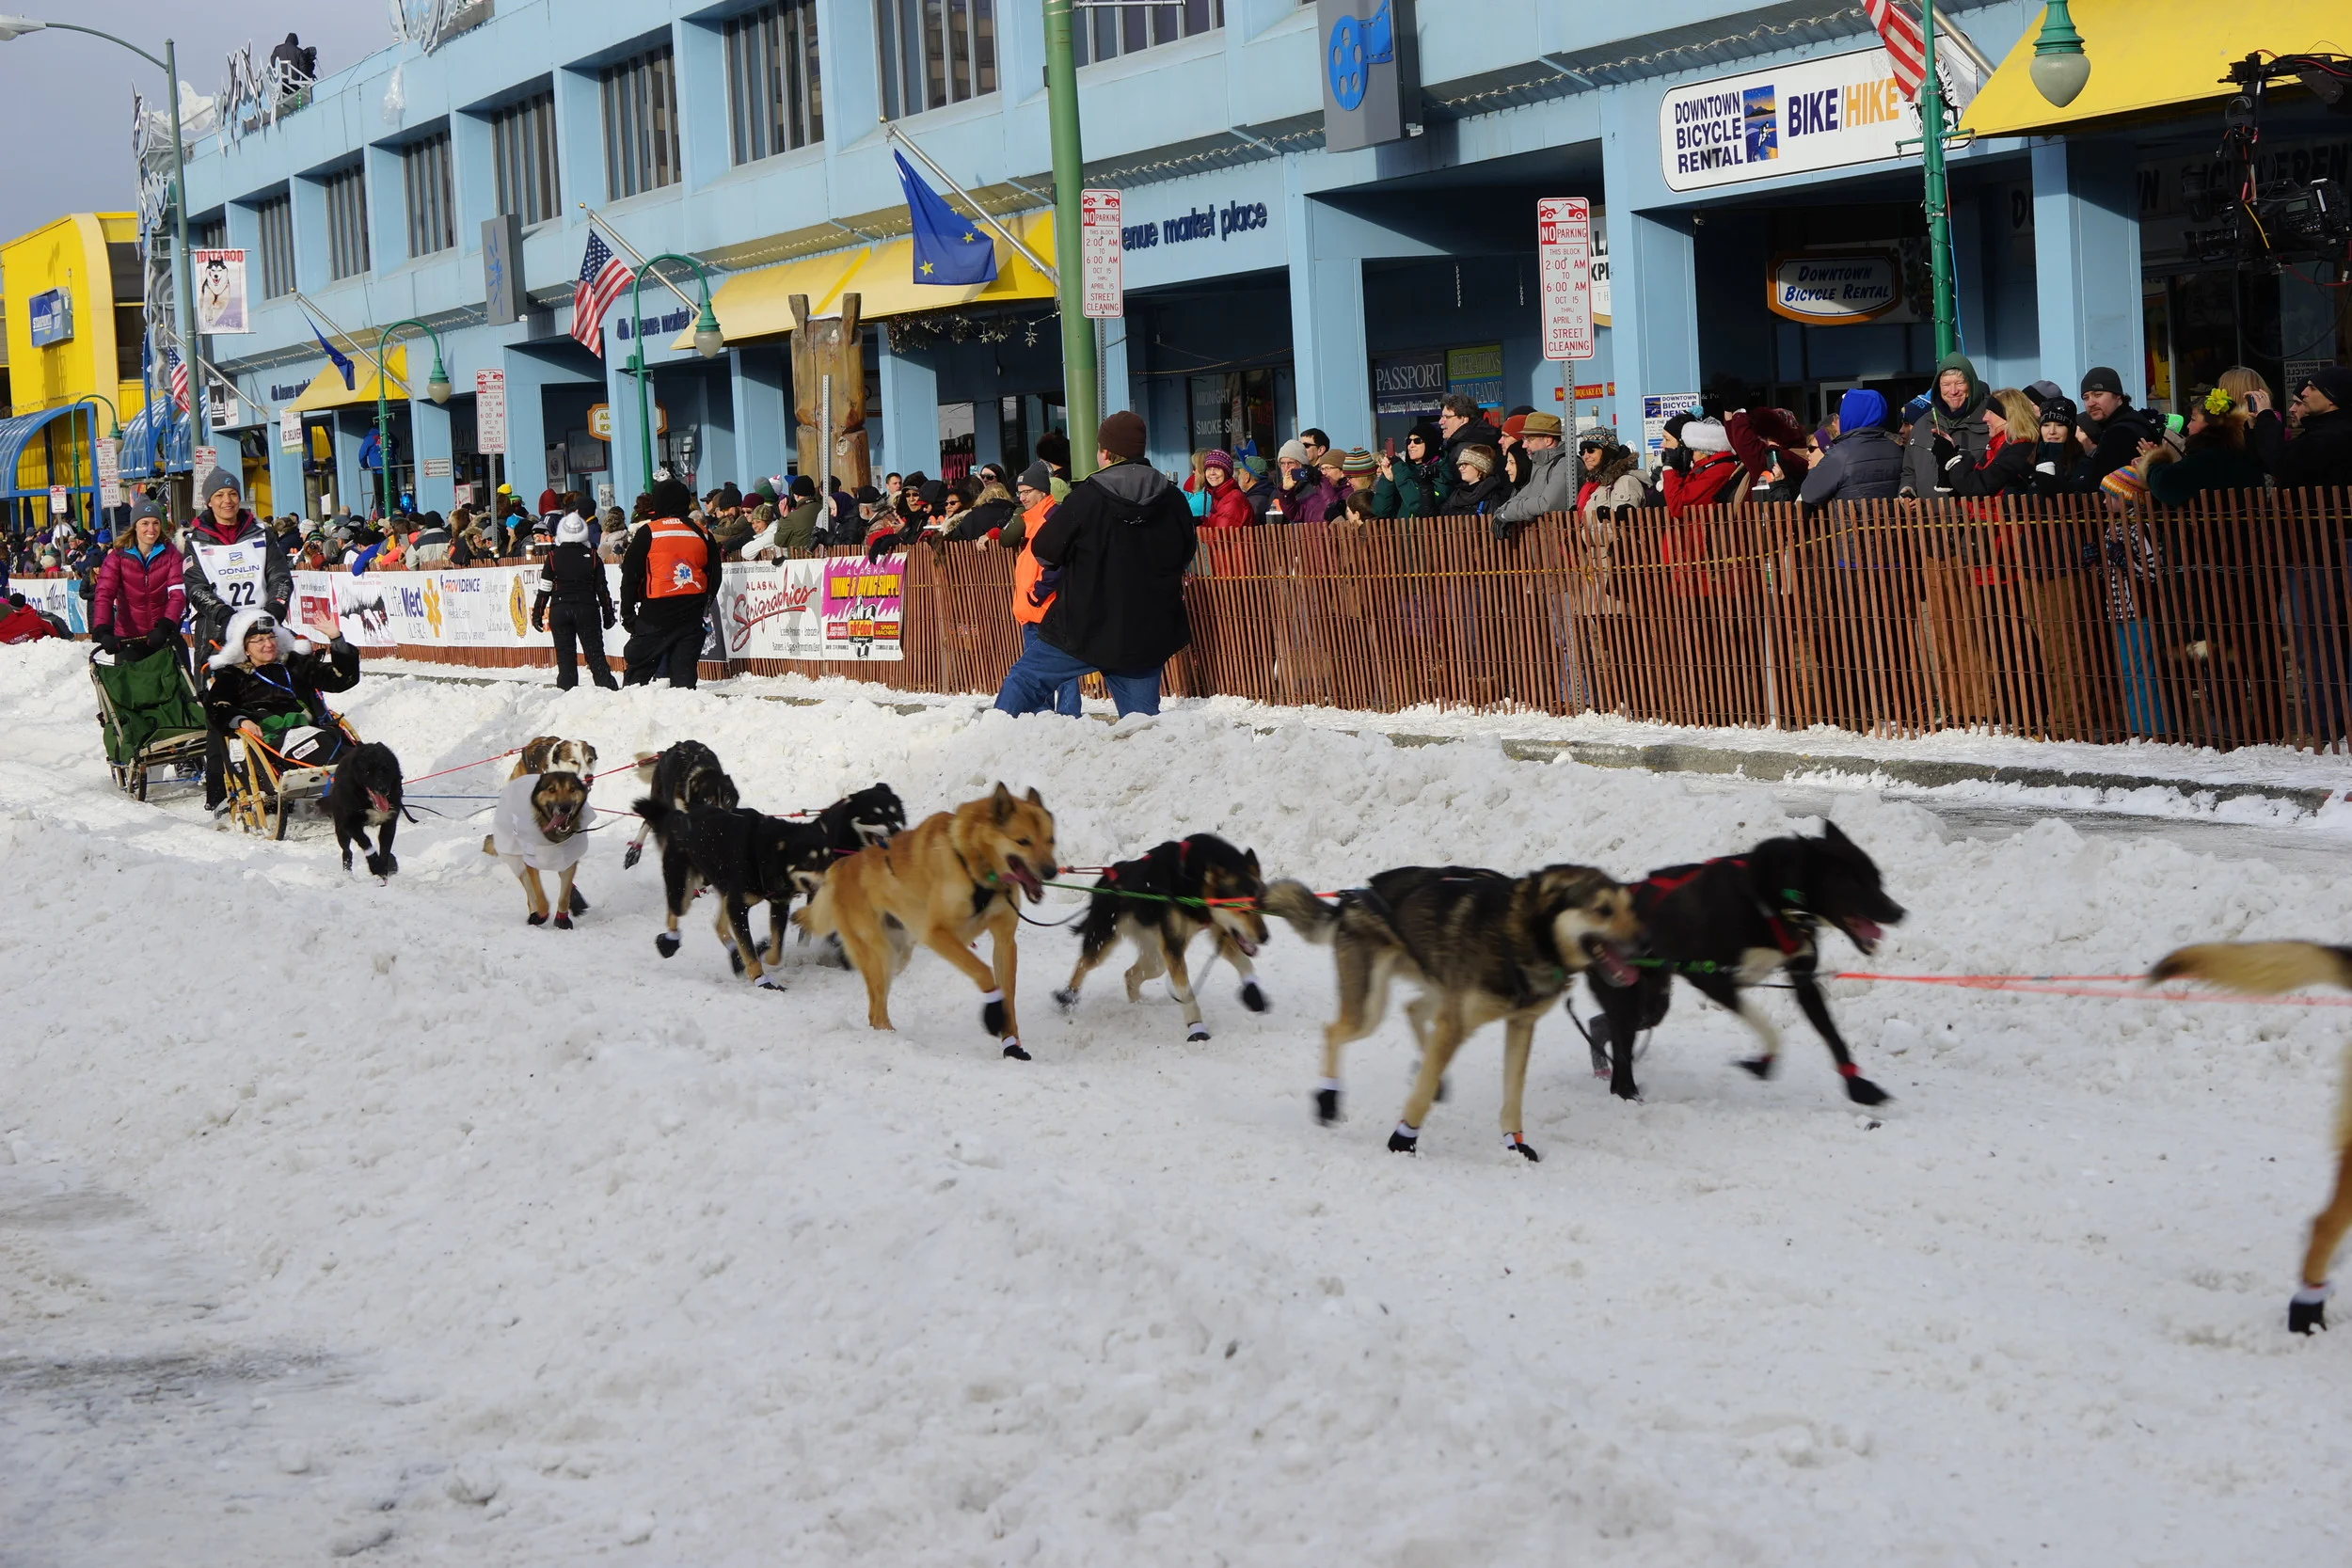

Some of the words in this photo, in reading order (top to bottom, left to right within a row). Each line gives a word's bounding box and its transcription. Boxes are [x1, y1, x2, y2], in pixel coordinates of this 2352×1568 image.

[1675, 91, 1740, 124] DOWNTOWN
[1677, 117, 1742, 150] BICYCLE
[1677, 144, 1743, 174] RENTAL
[1084, 211, 1095, 225] NO
[1095, 214, 1120, 223] PARKING
[1121, 221, 1159, 251] enue
[1163, 203, 1216, 245] market
[1220, 199, 1268, 242] place
[1541, 225, 1556, 242] NO
[1556, 227, 1587, 239] PARKING
[1086, 238, 1103, 247] 2:00
[1086, 256, 1104, 264] 6:00
[1108, 256, 1119, 264] AM
[1546, 259, 1566, 270] 2:00
[1574, 259, 1586, 269] AM
[1562, 271, 1570, 280] TO
[1546, 281, 1567, 293] 6:00
[1574, 281, 1587, 291] AM
[1090, 293, 1115, 301] STREET
[1554, 296, 1566, 305] OCT
[1572, 295, 1580, 304] 15
[1086, 302, 1120, 311] CLEANING
[1552, 315, 1571, 325] APRIL
[1576, 315, 1583, 324] 15
[631, 316, 660, 339] Aenue
[1552, 327, 1584, 339] STREET
[1548, 341, 1590, 352] CLEANING
[1451, 350, 1501, 376] ALTERATIONS
[1375, 363, 1442, 391] PASSPORT
[1197, 388, 1231, 406] MIDNIGHT
[1662, 401, 1697, 409] BICYCLE
[1662, 409, 1681, 418] REN
[1196, 419, 1223, 436] SMOKE
[218, 564, 261, 576] DONLIN
[846, 566, 885, 576] ALASKA
[226, 572, 255, 581] GOLD
[444, 578, 480, 593] PROVIDENCE
[746, 580, 778, 592] ALASKA
[229, 581, 256, 607] 22
[401, 587, 424, 618] Med
[732, 564, 818, 652] Serigraphics
